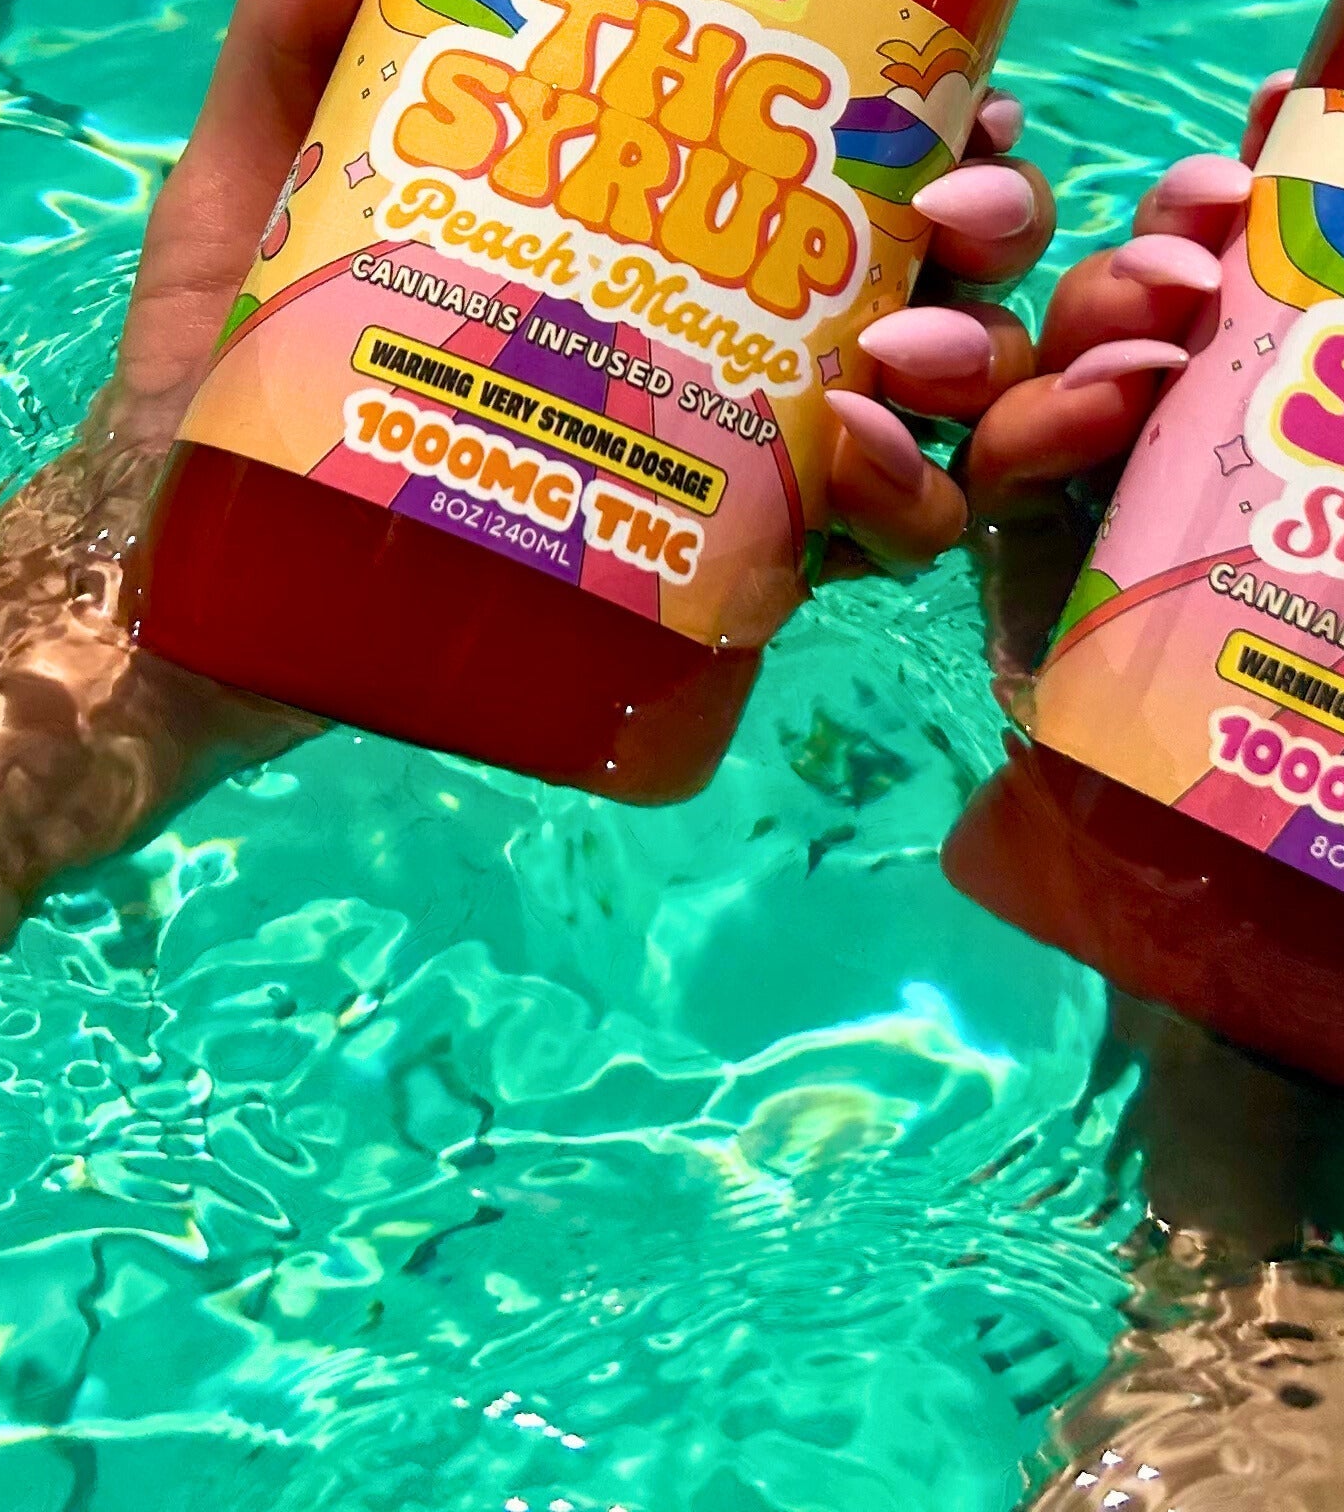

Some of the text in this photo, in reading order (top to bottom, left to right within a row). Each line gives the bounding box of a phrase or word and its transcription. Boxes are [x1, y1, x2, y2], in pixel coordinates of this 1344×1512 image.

[393, 49, 856, 319] SYRUP
[351, 254, 779, 445] CANNABIS INFUSED SYRUP
[385, 179, 802, 385] Peach Mango
[357, 401, 699, 576] 1000MG THC
[369, 339, 714, 503] WARNING VERY STRONG DOSAGE
